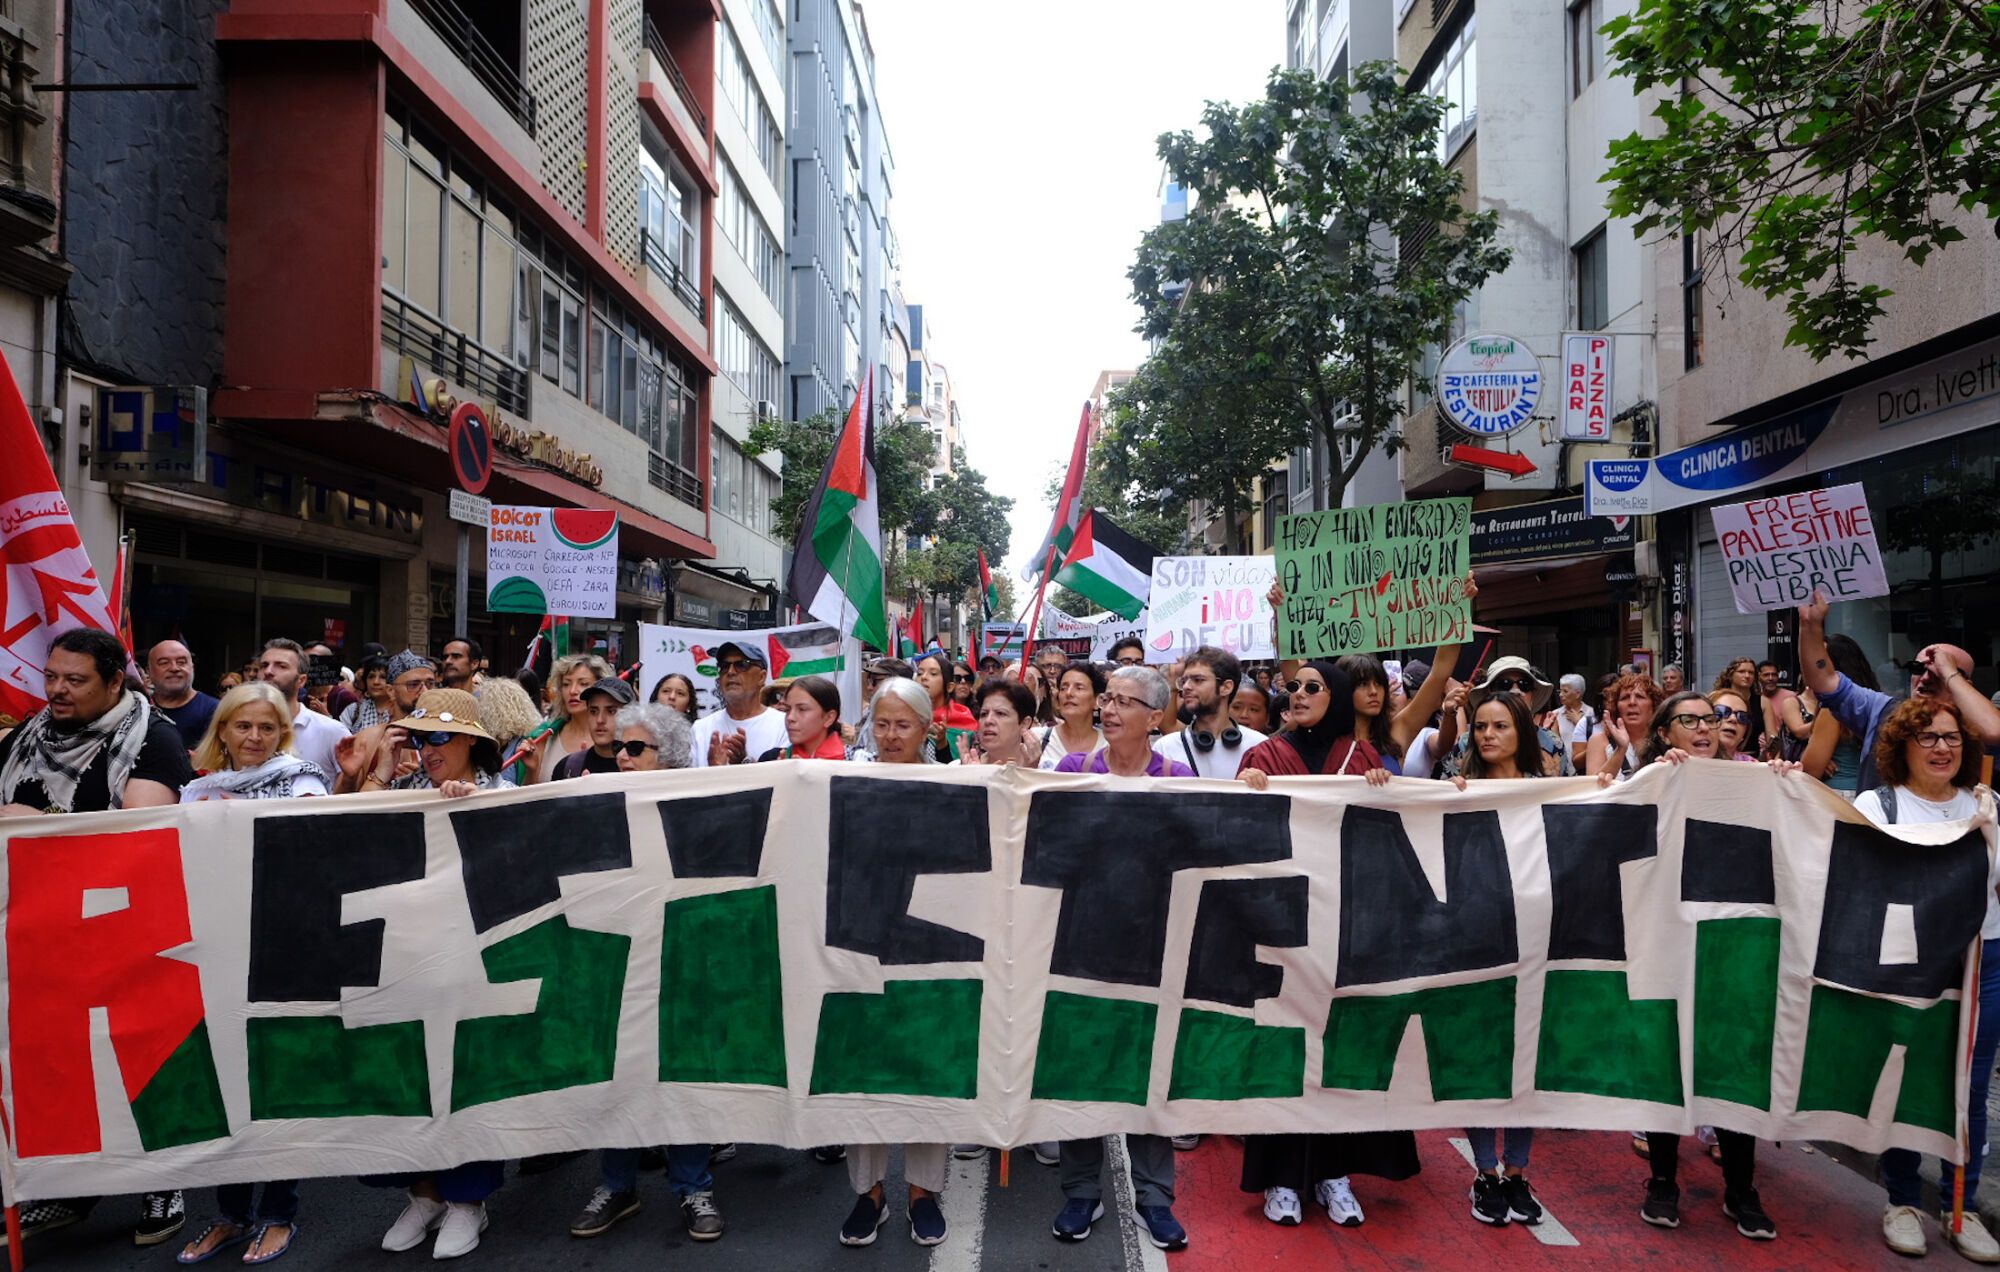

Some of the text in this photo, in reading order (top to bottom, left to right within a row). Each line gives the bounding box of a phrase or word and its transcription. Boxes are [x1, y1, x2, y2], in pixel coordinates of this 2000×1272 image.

[1470, 341, 1515, 358] Tropical
[1463, 374, 1518, 387] CAFETERIA
[1569, 363, 1587, 411] BAR
[1589, 340, 1606, 436] PIZZAS
[1878, 354, 2000, 424] Dra. Ivett
[1445, 373, 1537, 432] RESTAURANTE
[1465, 388, 1516, 413] TERTULIA
[1681, 423, 1806, 479] CLINICA DENTAL
[1602, 465, 1641, 473] CLINICA
[1603, 475, 1640, 483] DENTAL
[1744, 490, 1832, 526] FREE
[491, 528, 536, 544] ISRAEL
[1282, 500, 1468, 551] HOY HAN ENTERRADO
[489, 561, 511, 571] COCA
[515, 562, 535, 571] COLA
[543, 563, 577, 574] GOOGLE
[490, 547, 537, 559] MICROSOFT
[544, 549, 594, 561] CARREFOUR
[1284, 559, 1301, 595] A
[1312, 550, 1333, 592] UN
[1438, 538, 1458, 577] EN
[547, 578, 609, 592] UEFA ZARA
[1156, 558, 1206, 588] SON
[551, 598, 608, 611] EUROVISION
[1287, 594, 1325, 626] GAZA
[1341, 584, 1377, 618] TU
[1387, 576, 1464, 613] SILENCIO
[1376, 615, 1397, 648] LA
[8, 776, 1988, 1157] RESISTENCIA
